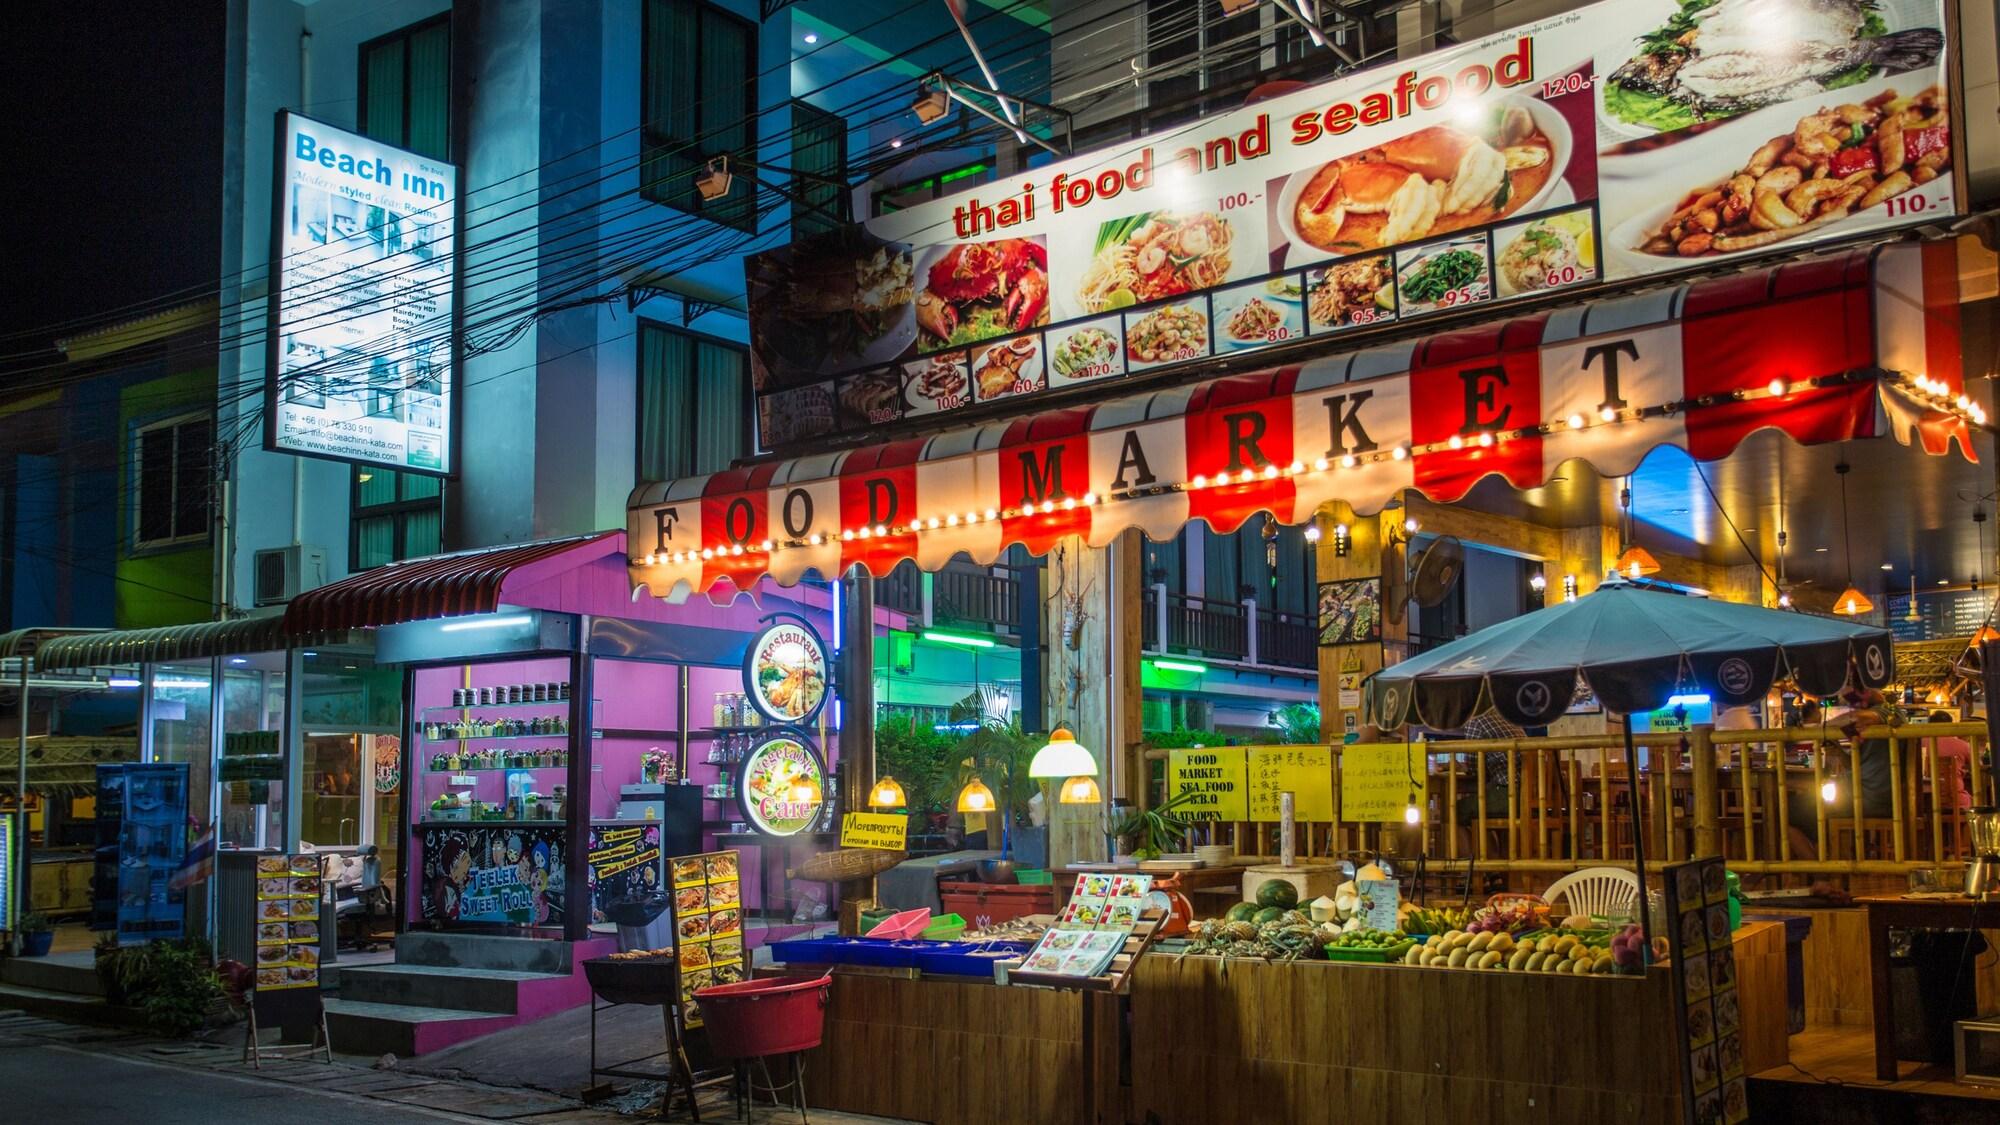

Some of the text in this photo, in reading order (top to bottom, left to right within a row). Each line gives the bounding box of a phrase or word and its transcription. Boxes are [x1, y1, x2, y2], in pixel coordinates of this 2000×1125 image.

[1541, 71, 1601, 99] 120.-
[952, 37, 1535, 240] thai food and seafood
[295, 132, 446, 201] Beach inn
[339, 185, 372, 201] styled
[404, 202, 438, 220] Rooms
[1217, 190, 1263, 213] 100.-
[1883, 192, 1950, 219] 110.-
[1545, 266, 1595, 288] 60.-
[1443, 287, 1490, 307] 95.-
[392, 308, 426, 320] Hairdryer
[392, 316, 414, 327] Books
[1351, 307, 1390, 327] 95.-
[1265, 326, 1302, 345] 80.-
[1173, 346, 1205, 362] 120.-
[1087, 362, 1121, 379] 120.-
[1013, 378, 1046, 396] 60.-
[935, 394, 972, 412] 100.-
[868, 408, 903, 425] 120.-
[343, 422, 357, 432] 330
[358, 424, 373, 434] 910
[311, 428, 404, 451] info@beachinn-kata.com
[654, 338, 1641, 555] FOOD MARKET
[306, 440, 398, 462] www.beachinn-kata.com
[761, 631, 822, 665] Restaurant
[754, 745, 817, 776] Vegetable
[1187, 755, 1217, 765] FOOD
[1179, 768, 1223, 779] MARKET
[470, 865, 519, 891] TEELEK
[461, 888, 534, 916] SWEET ROLL
